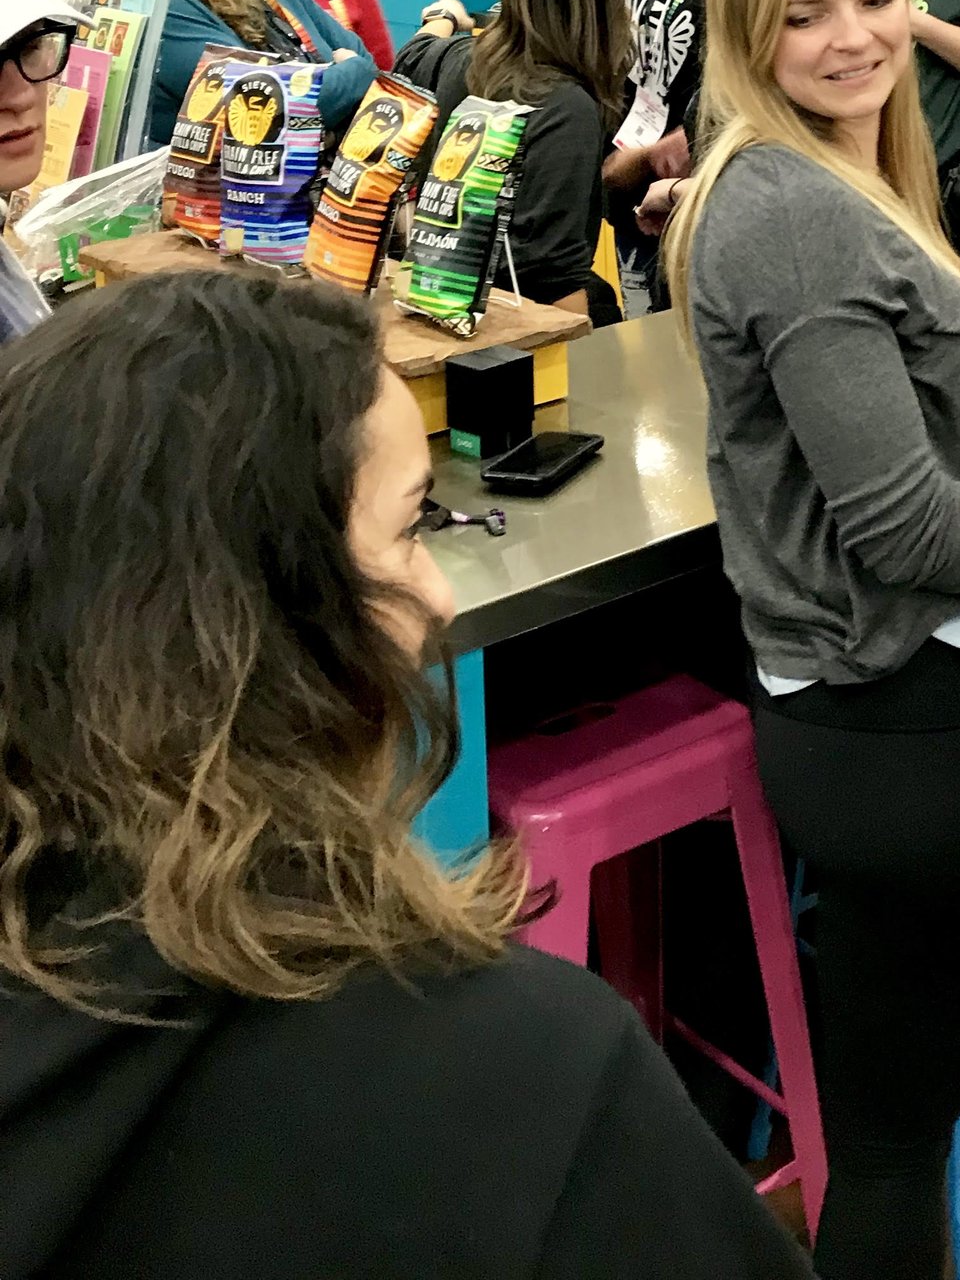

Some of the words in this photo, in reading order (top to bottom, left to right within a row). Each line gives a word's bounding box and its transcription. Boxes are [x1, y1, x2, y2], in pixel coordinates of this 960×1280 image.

[241, 80, 274, 96] SIETE
[376, 103, 399, 125] SIETE
[190, 125, 212, 143] FREE
[251, 150, 280, 166] FREE
[167, 162, 195, 179] FUEGO
[227, 189, 266, 205] RANCH
[416, 230, 460, 251] LIMÓN
